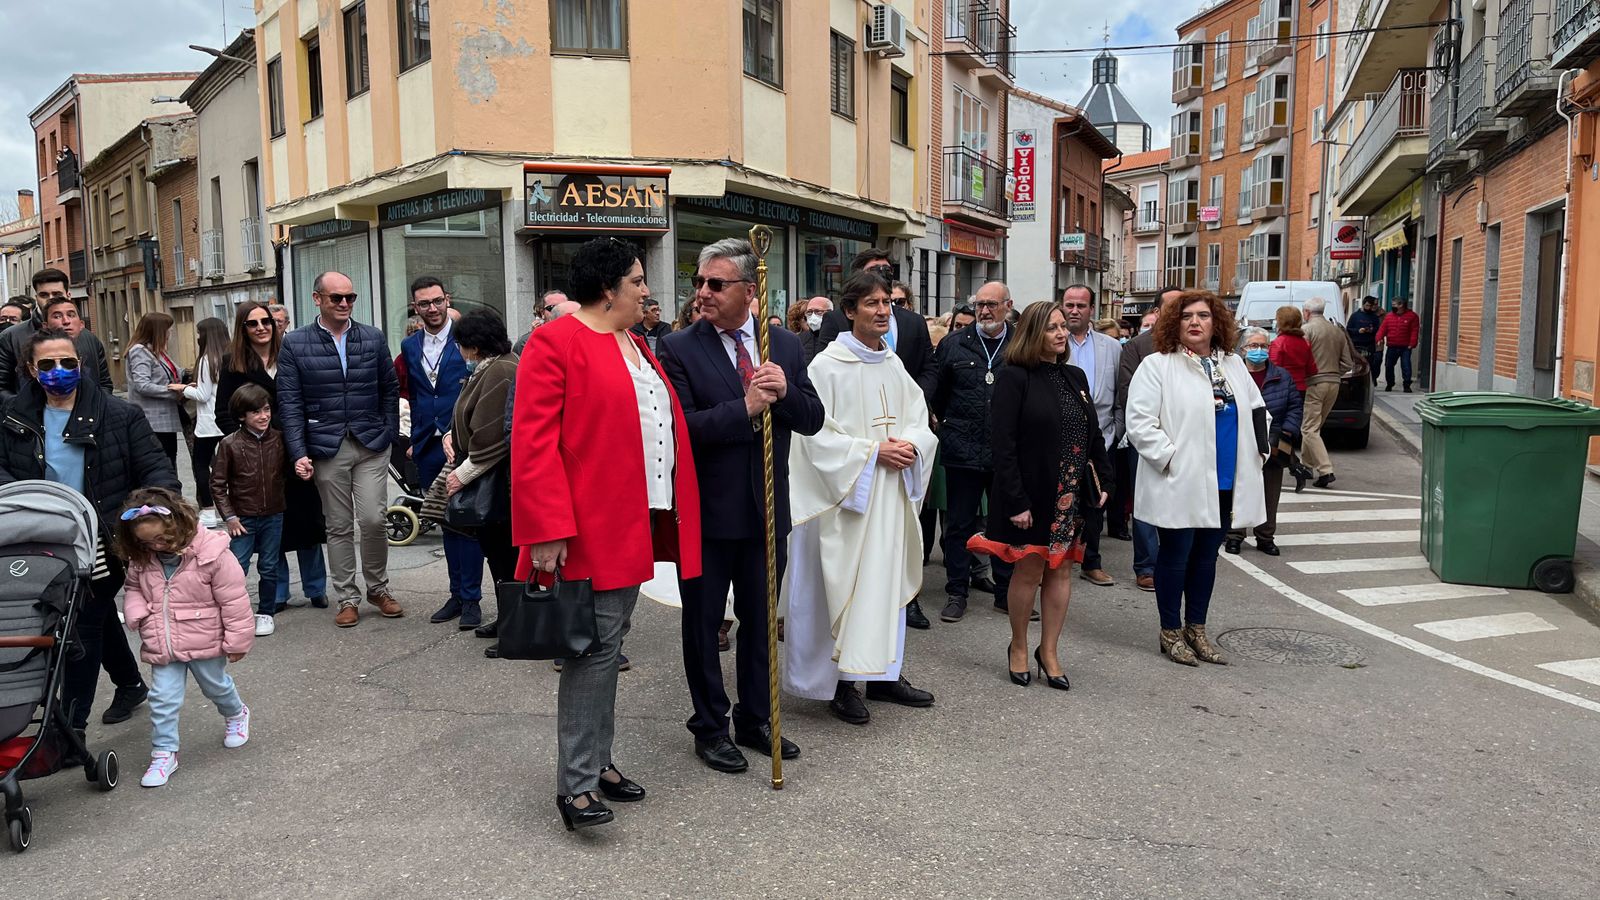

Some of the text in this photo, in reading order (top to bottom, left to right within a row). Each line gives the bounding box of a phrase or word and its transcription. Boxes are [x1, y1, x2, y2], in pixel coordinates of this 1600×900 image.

[1017, 148, 1031, 201] VICTOR
[559, 182, 667, 208] AESAN
[387, 202, 420, 221] ANTENAS
[422, 197, 435, 214] DE
[529, 212, 579, 223] Electricidad
[586, 212, 668, 225] Telecomunicaciones
[758, 201, 800, 224] ELECTRICAS
[808, 212, 873, 238] TELECOMUNICACIONES
